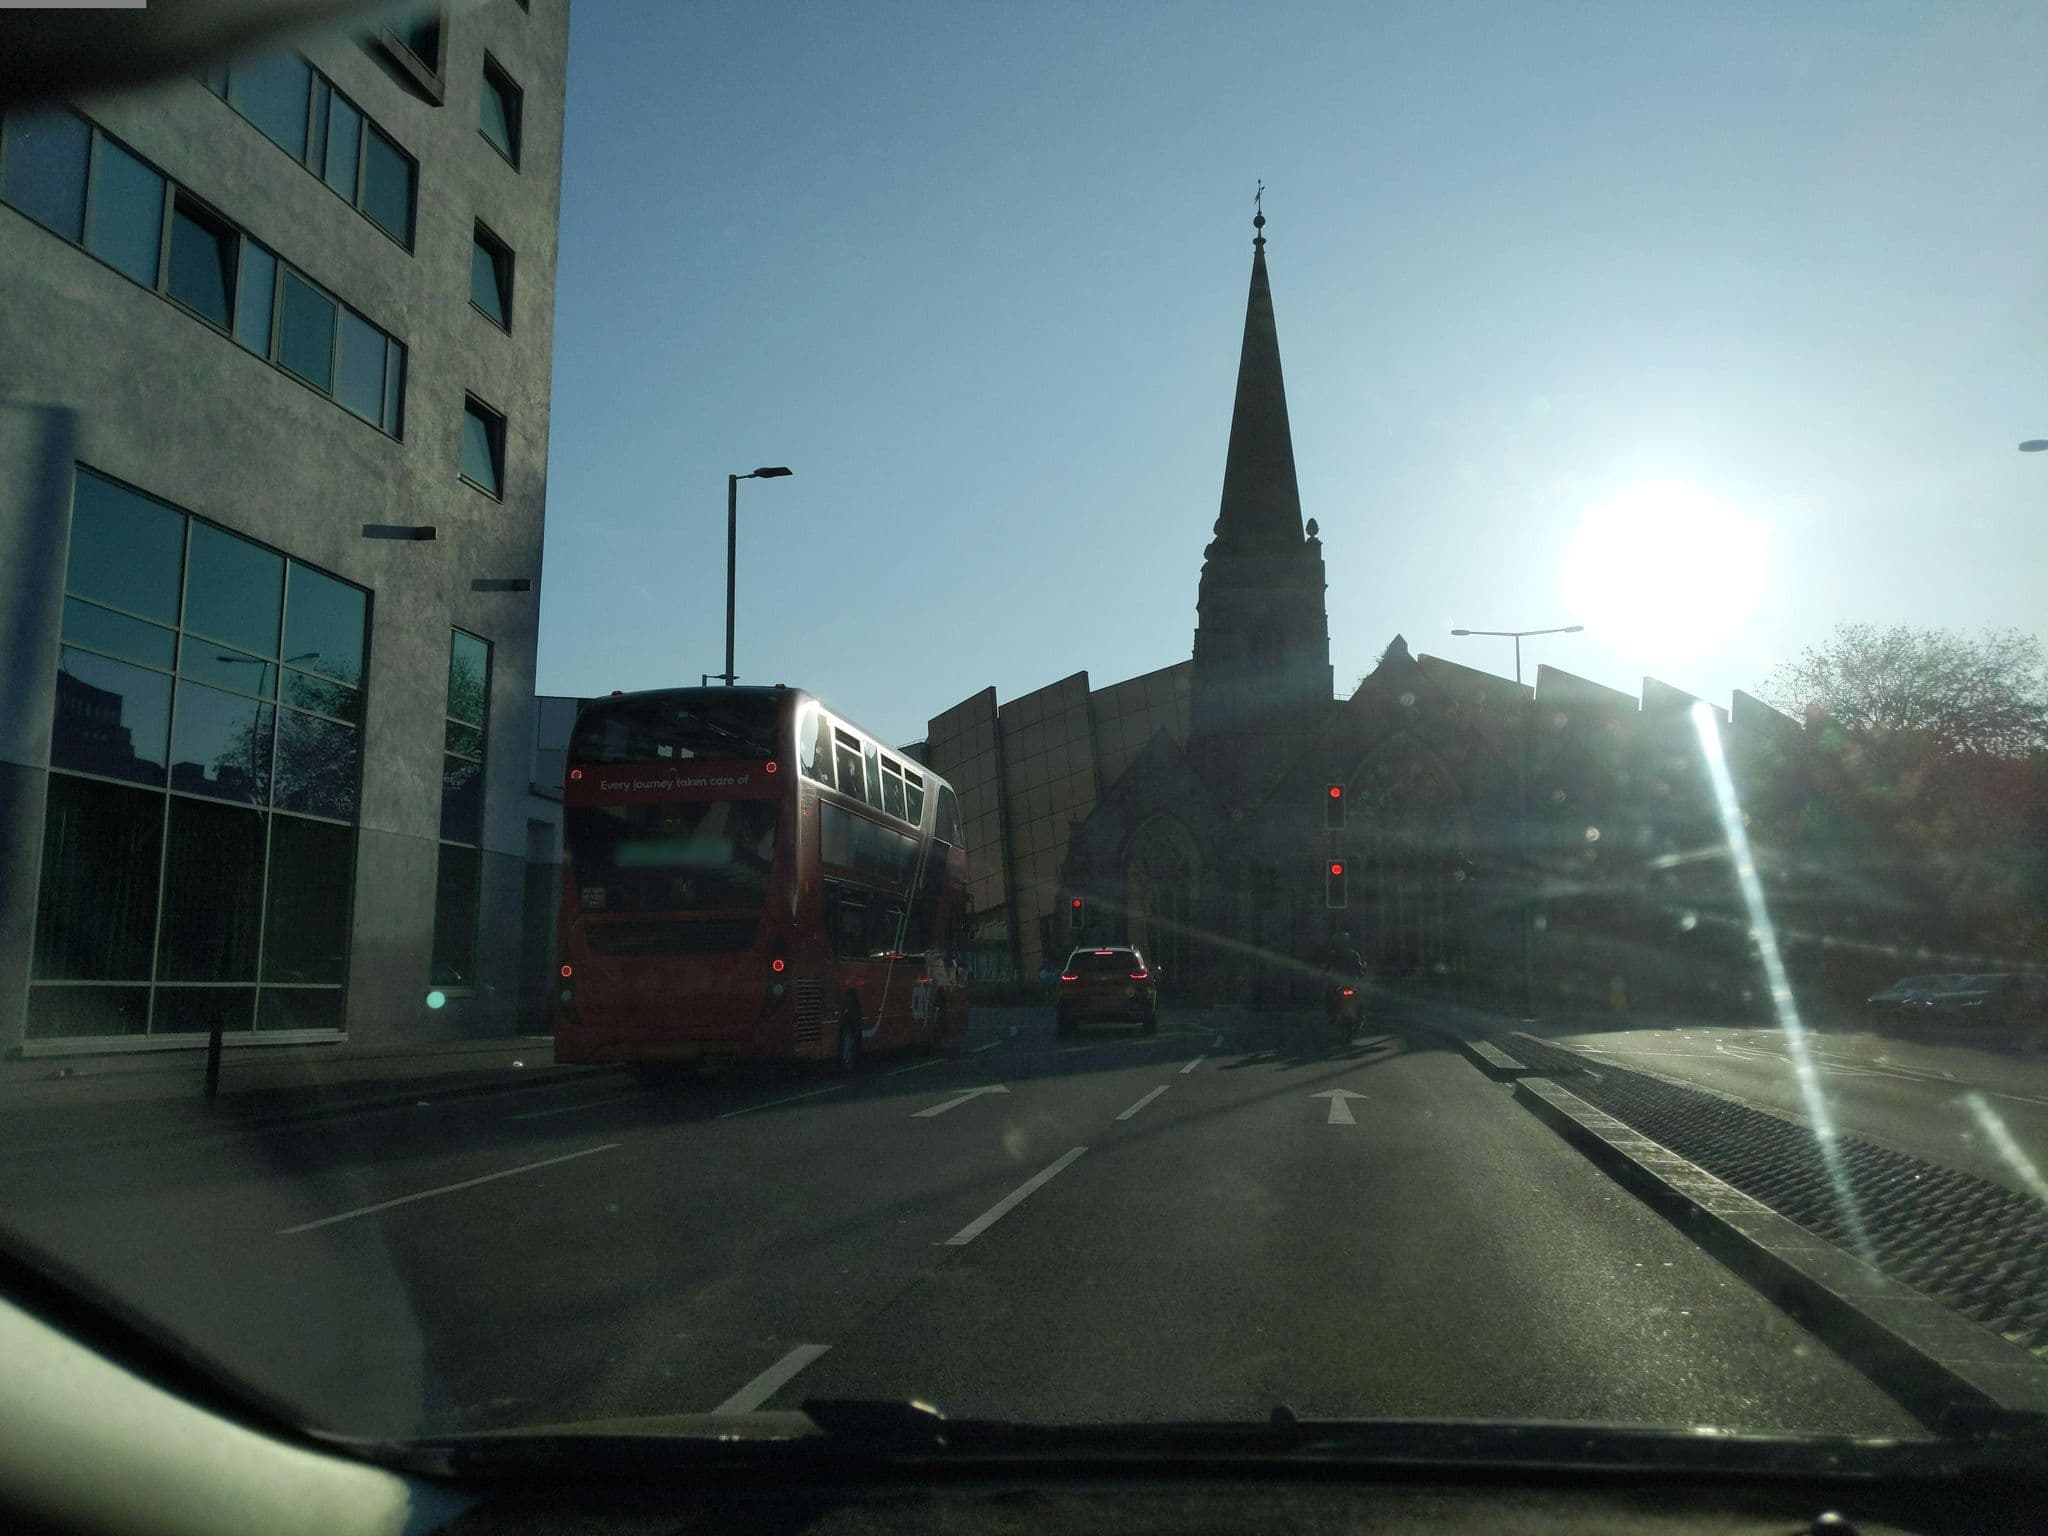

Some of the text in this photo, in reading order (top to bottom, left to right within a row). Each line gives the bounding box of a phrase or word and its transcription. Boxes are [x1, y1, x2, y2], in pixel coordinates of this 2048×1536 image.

[600, 774, 750, 793] Every journey taken care of
